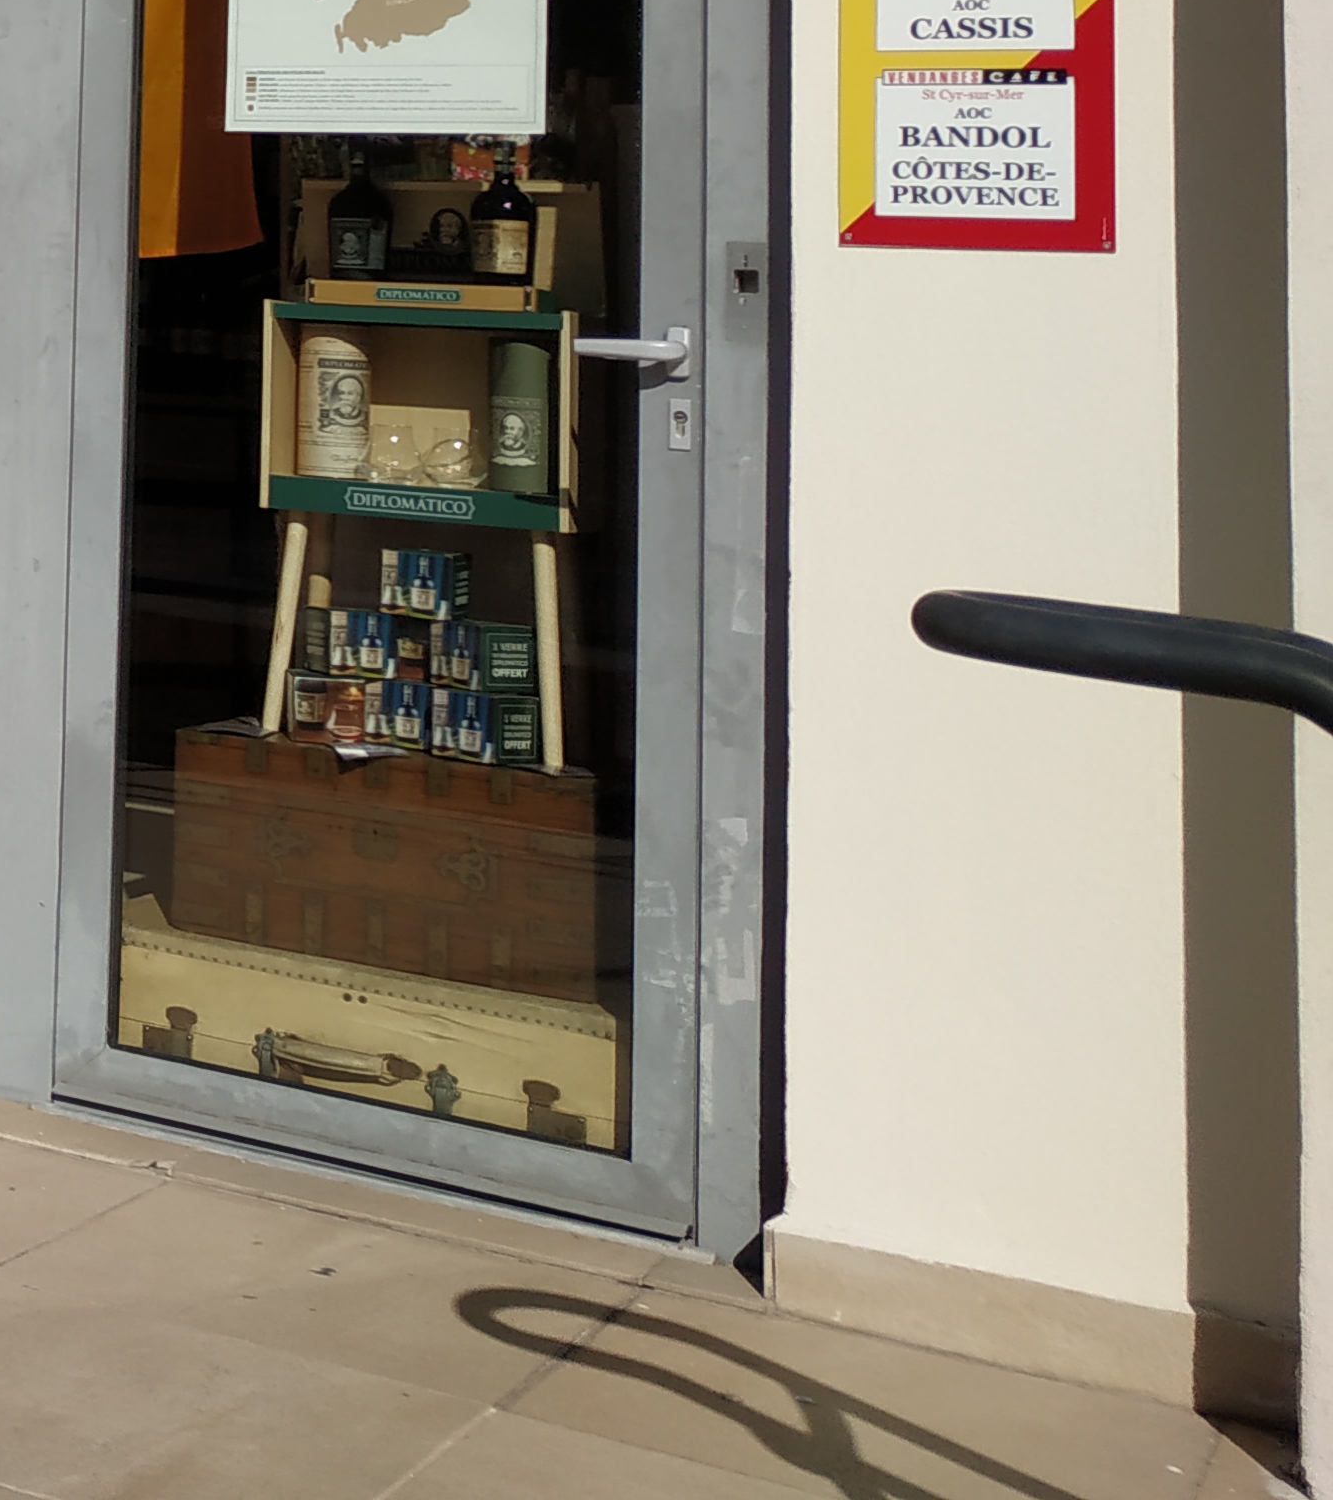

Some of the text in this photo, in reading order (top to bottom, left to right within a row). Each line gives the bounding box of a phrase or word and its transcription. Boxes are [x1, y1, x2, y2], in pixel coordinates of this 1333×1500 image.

[910, 17, 1034, 40] CASSIS
[888, 71, 979, 85] VENDANGES
[939, 88, 1025, 102] Cyr-sur-Mer
[954, 106, 992, 119] AOC
[898, 126, 1052, 149] BANDOL
[892, 155, 1057, 181] CÔTES-DE-
[890, 185, 1060, 206] PROVENCE
[492, 668, 528, 678] OFFERT
